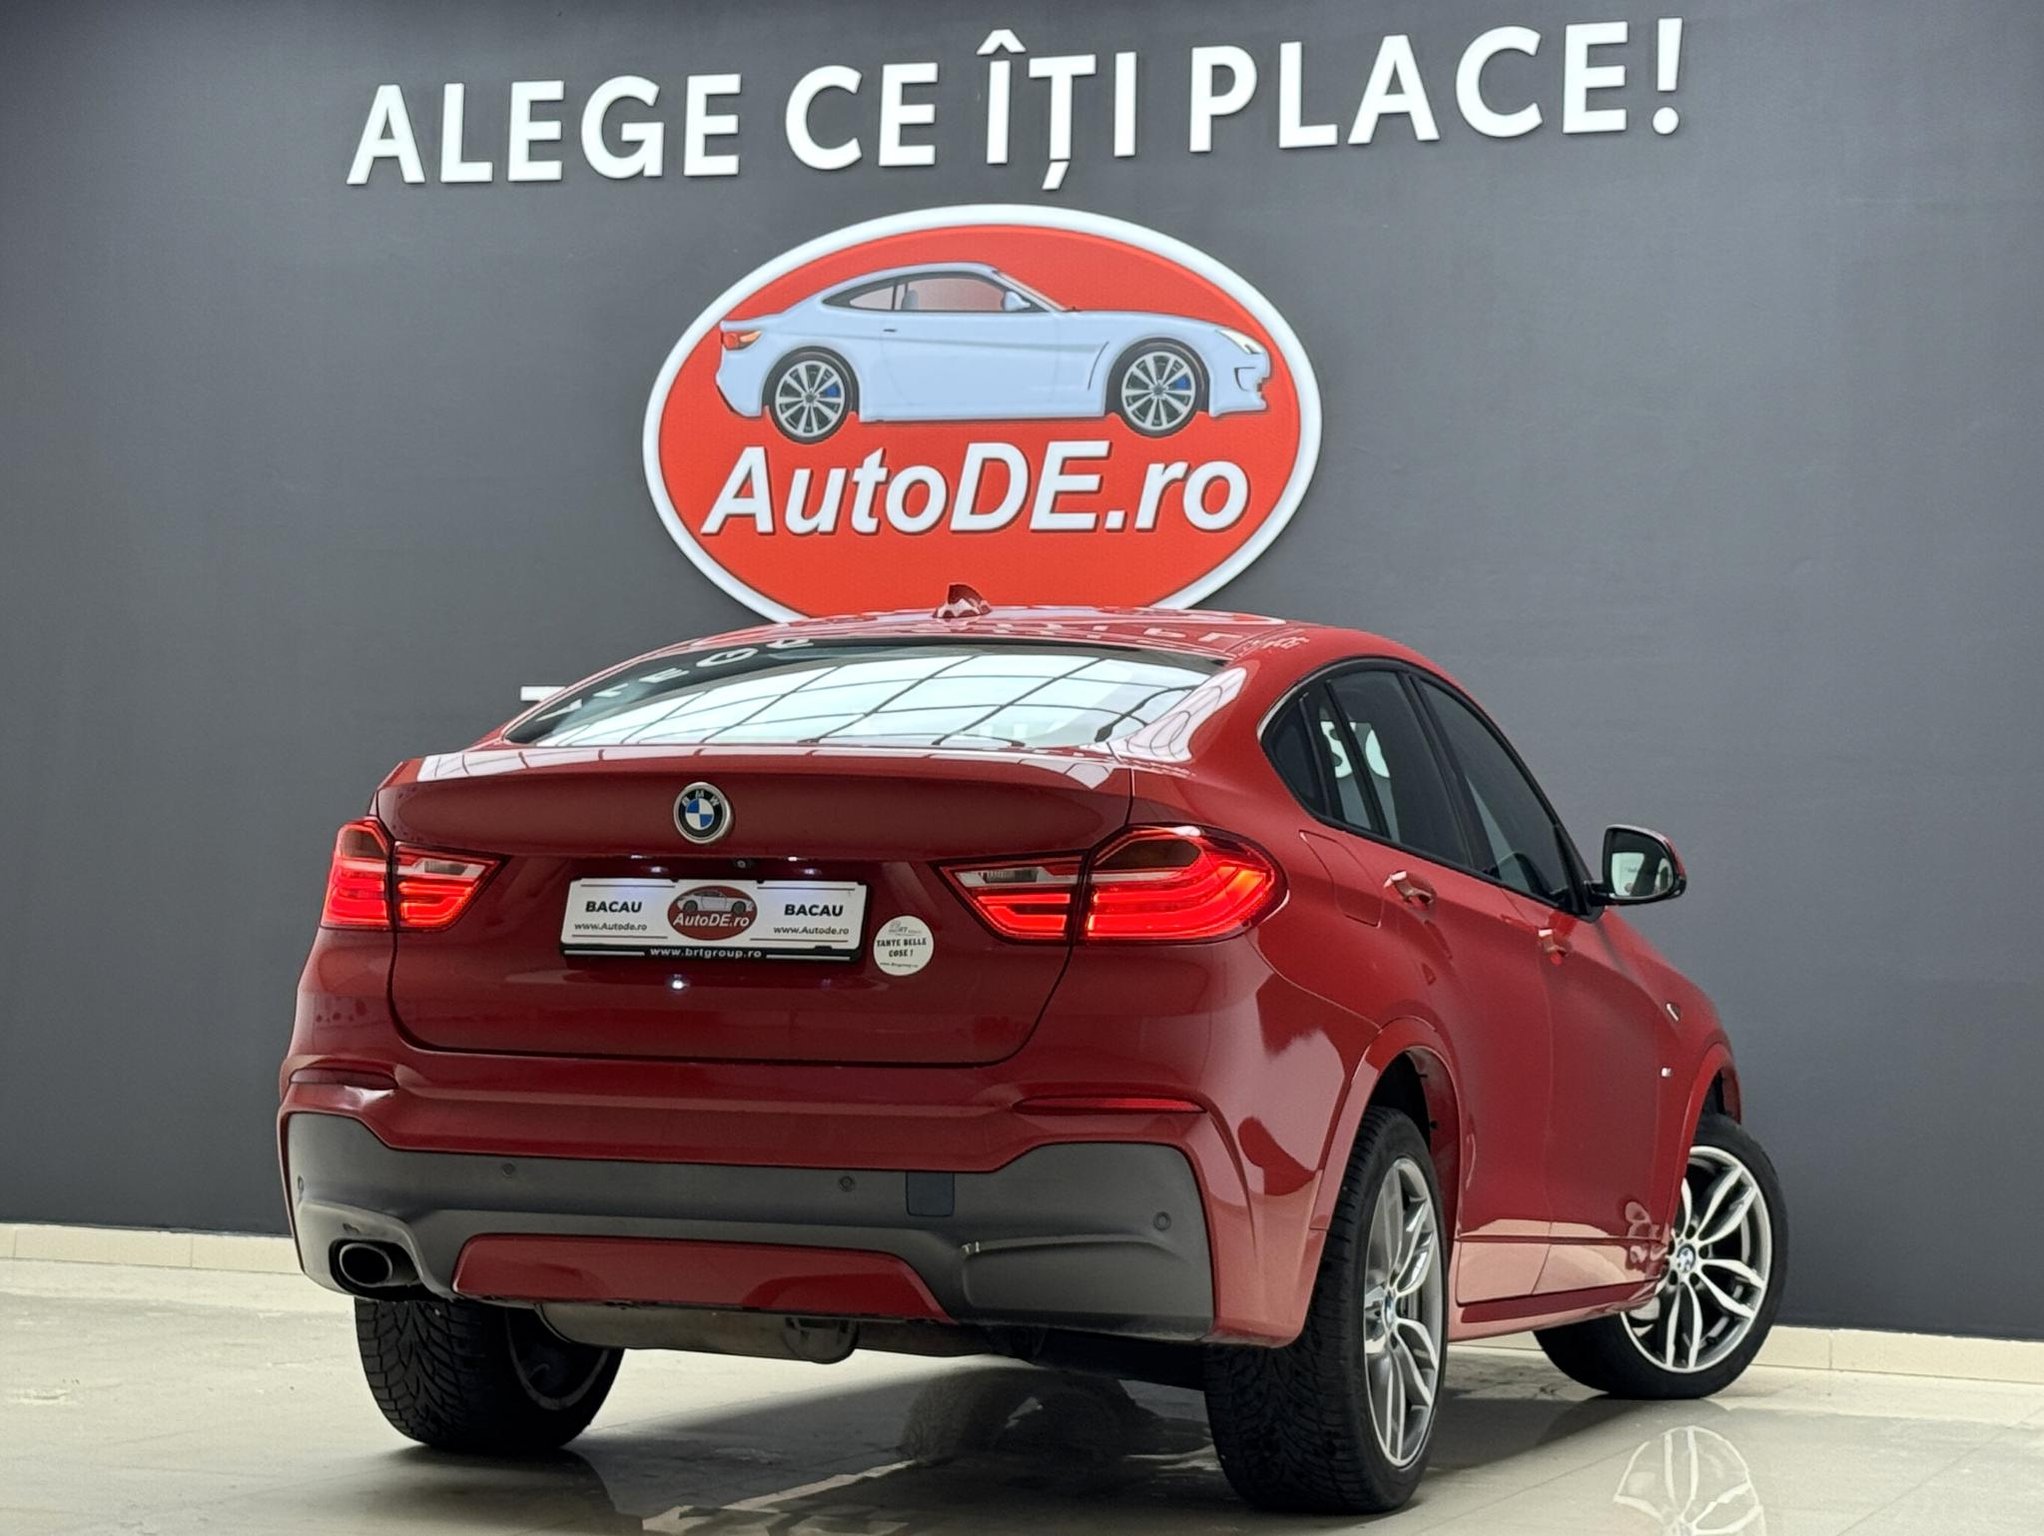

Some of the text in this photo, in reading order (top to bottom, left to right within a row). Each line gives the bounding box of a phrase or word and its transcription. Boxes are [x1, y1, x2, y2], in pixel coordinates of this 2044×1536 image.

[347, 73, 741, 185] ALEGE
[785, 62, 938, 170] CE
[1189, 17, 1684, 152] PLACE!
[699, 439, 1249, 536] AutoDE.ro
[681, 788, 720, 807] BMW
[585, 900, 643, 913] BACAU
[784, 904, 844, 917] BACAU
[672, 912, 750, 927] AutoDE.ro
